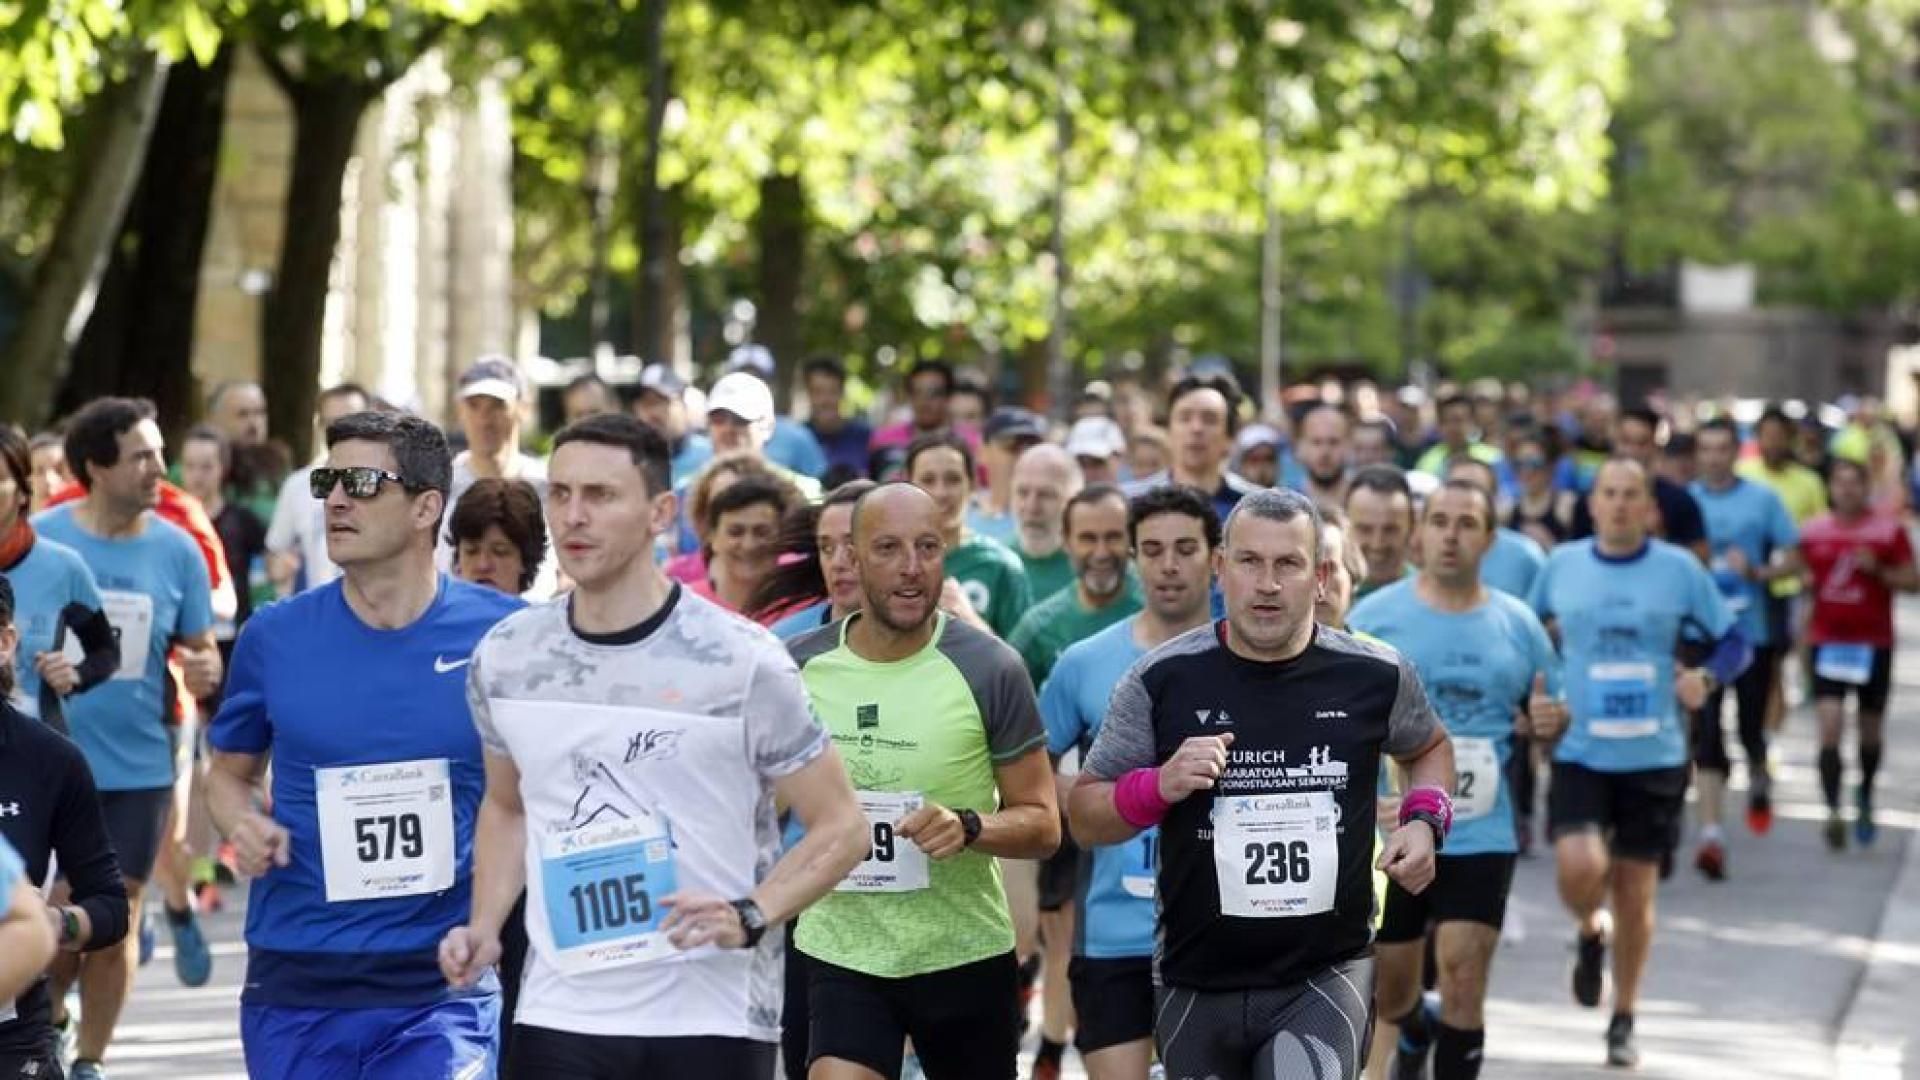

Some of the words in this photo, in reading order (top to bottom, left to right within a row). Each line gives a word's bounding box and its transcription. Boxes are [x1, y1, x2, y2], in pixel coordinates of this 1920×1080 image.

[355, 813, 423, 863] 579
[865, 821, 895, 862] 9
[1244, 840, 1310, 884] 236
[569, 872, 652, 934] 1105
